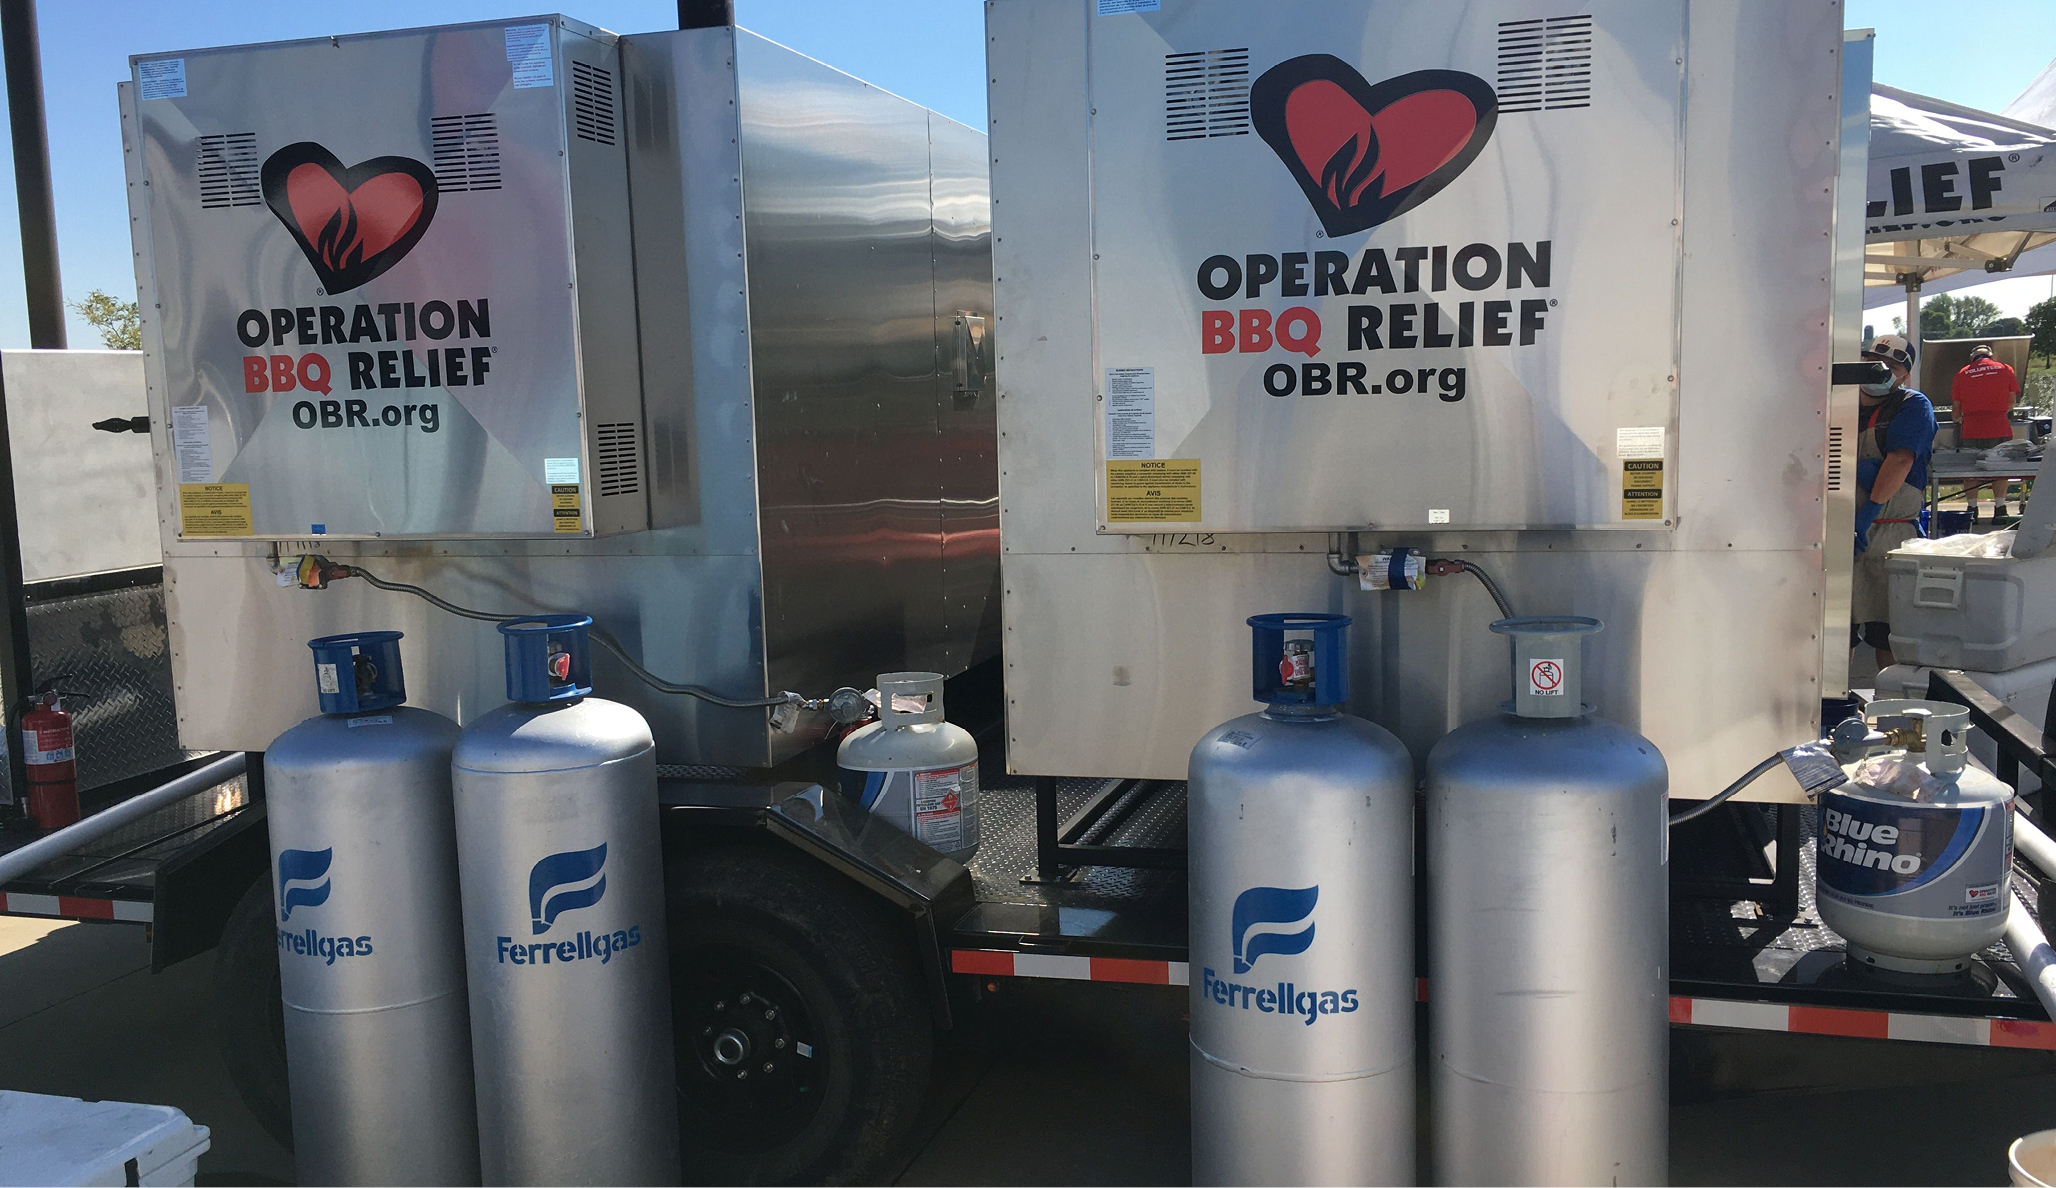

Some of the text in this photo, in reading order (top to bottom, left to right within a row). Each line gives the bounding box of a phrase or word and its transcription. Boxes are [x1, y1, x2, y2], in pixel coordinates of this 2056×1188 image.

[1197, 240, 1552, 300] OPERATION
[236, 298, 491, 347] OPERATION
[1201, 306, 1322, 358] BBQ
[242, 352, 333, 396] BBQ
[1263, 361, 1466, 402] OBR.org
[292, 399, 440, 433] OBR.org
[1826, 807, 1899, 845] Blue
[496, 925, 641, 965] Ferrellgas
[1203, 966, 1359, 1026] Ferrellgas
